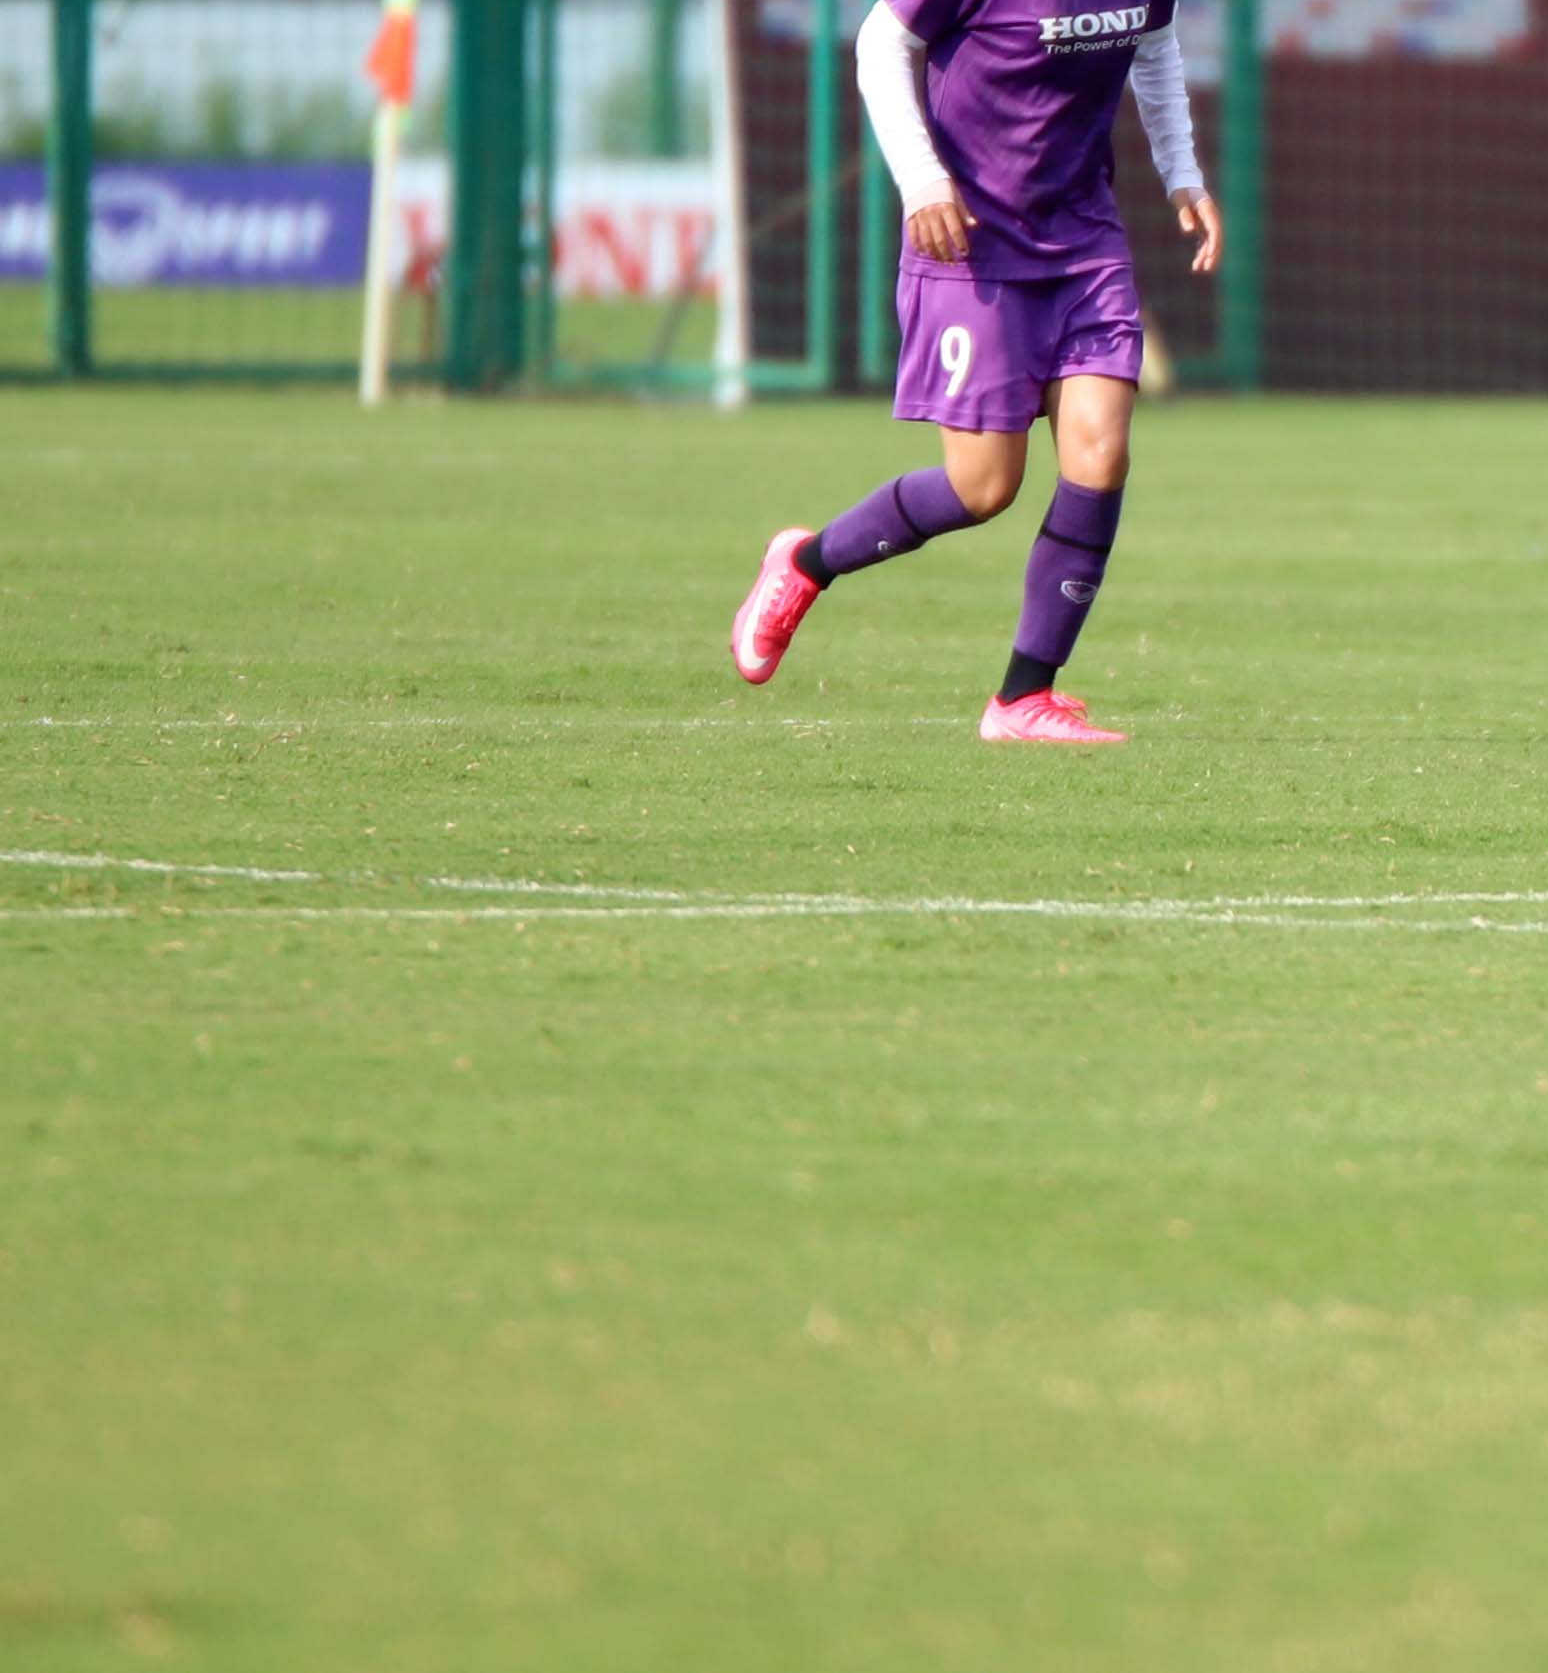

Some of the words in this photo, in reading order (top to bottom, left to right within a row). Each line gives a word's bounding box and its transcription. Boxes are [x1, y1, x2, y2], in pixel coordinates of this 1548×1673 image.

[1039, 3, 1149, 40] HOND
[1045, 42, 1071, 55] The
[1073, 38, 1115, 53] Power
[1116, 35, 1129, 47] of
[940, 325, 971, 398] 9
